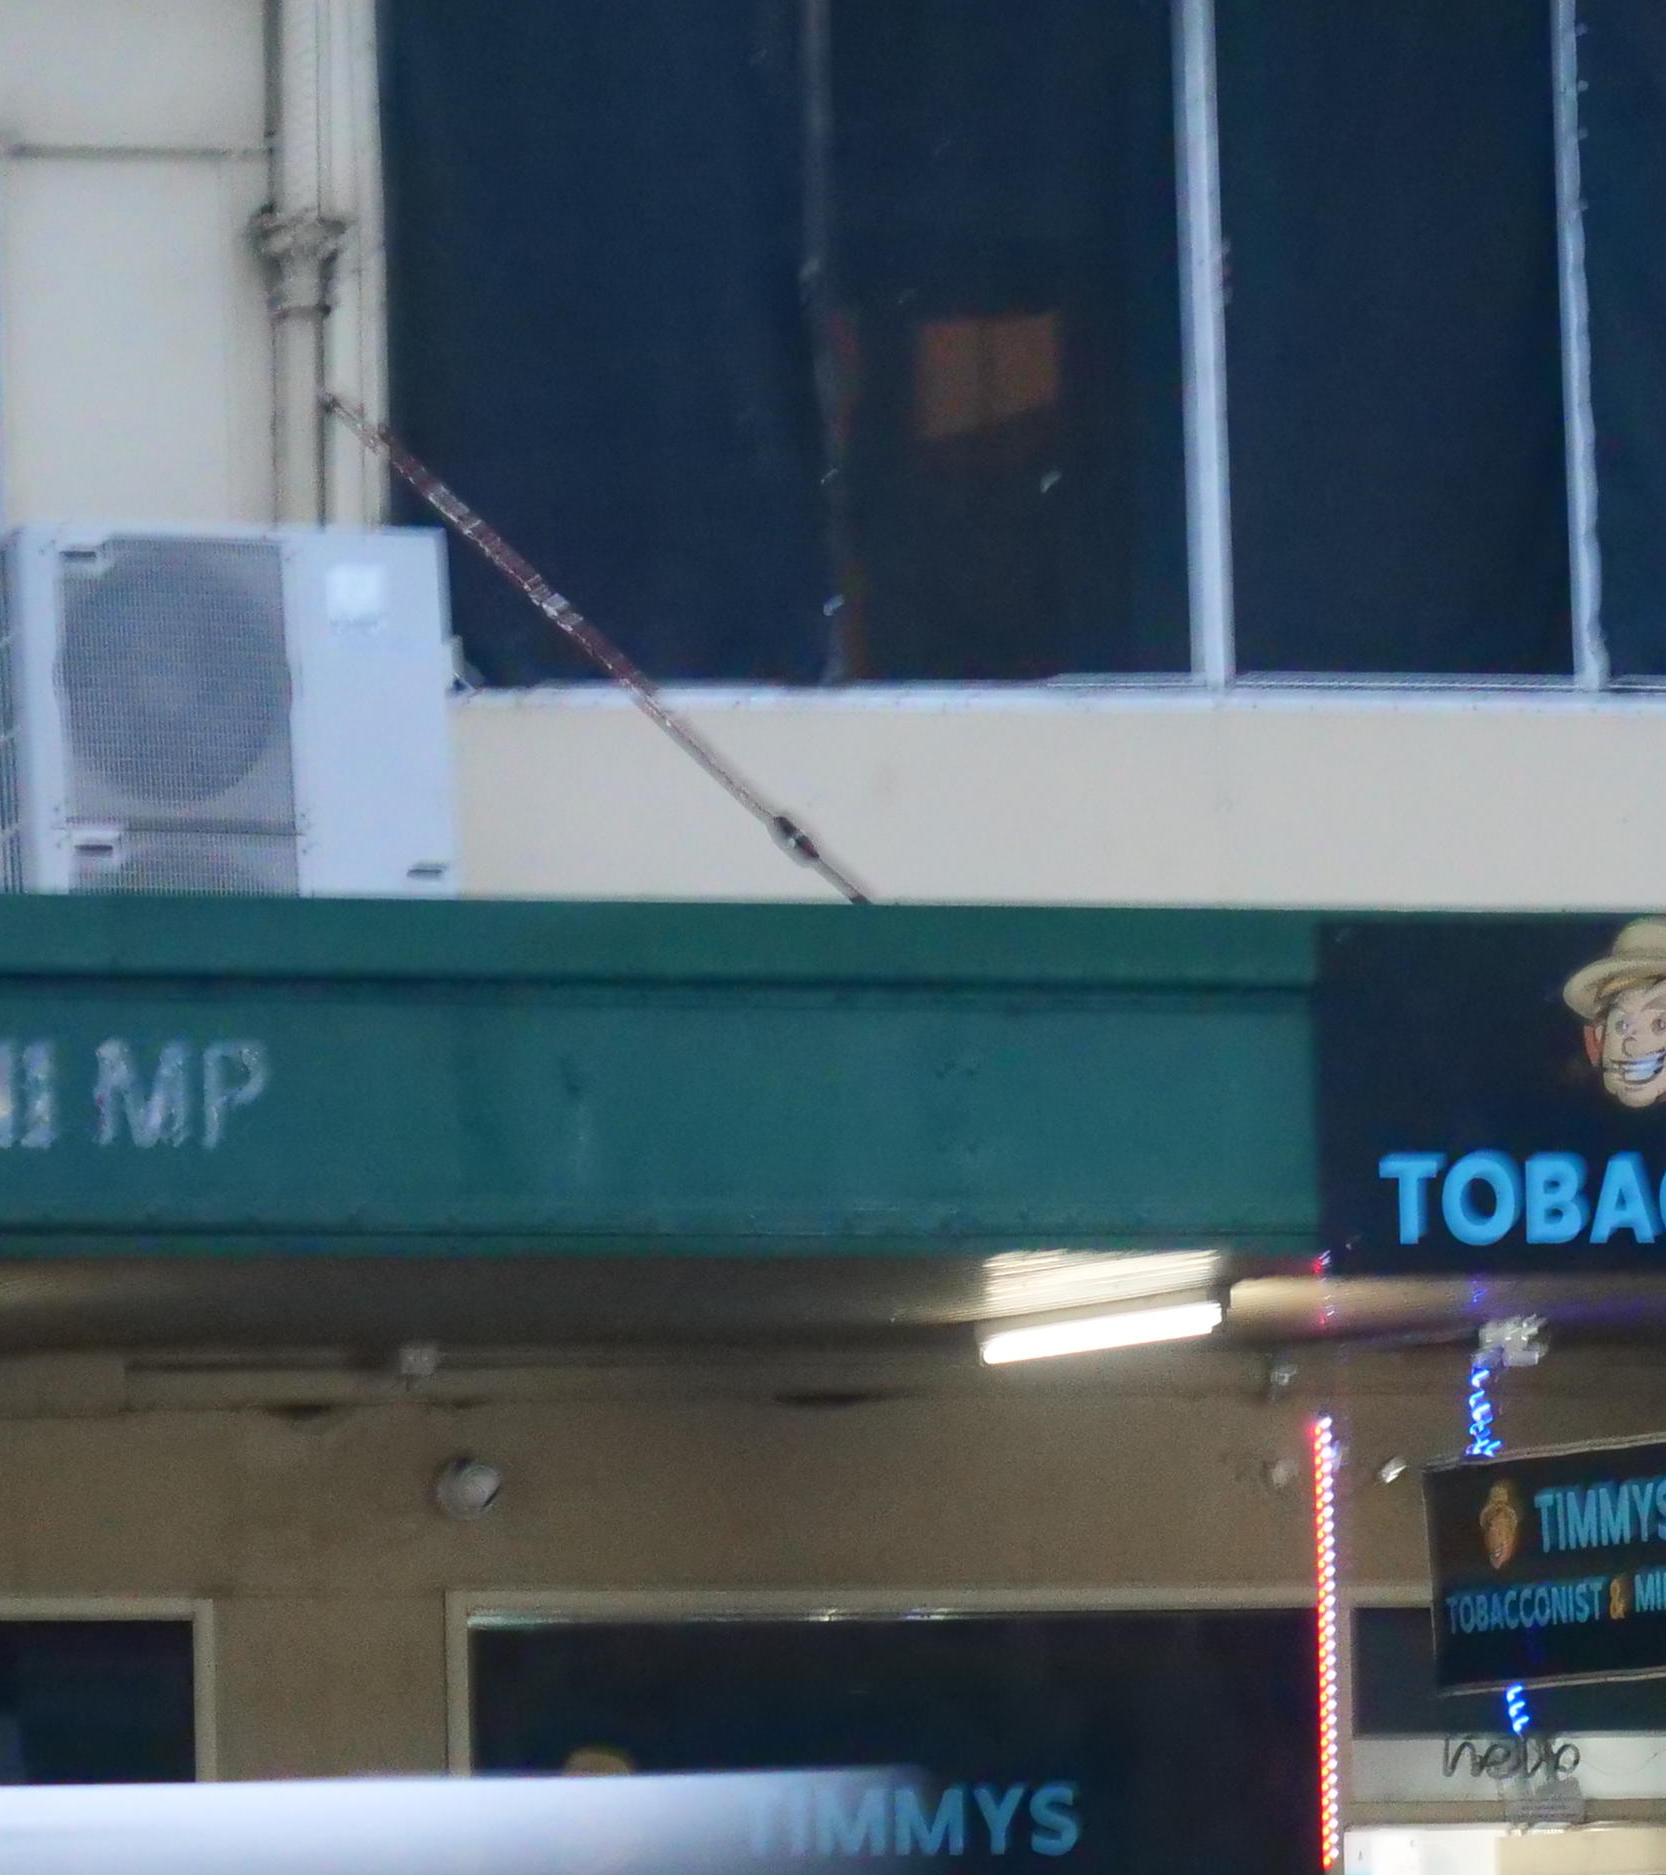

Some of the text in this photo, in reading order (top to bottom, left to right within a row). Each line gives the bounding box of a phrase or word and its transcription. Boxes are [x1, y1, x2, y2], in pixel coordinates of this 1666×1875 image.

[96, 1036, 270, 1149] MP
[1446, 1574, 1609, 1635] TOBACCONIST
[1609, 1573, 1628, 1620] &
[741, 1782, 1080, 1857] TIMMYS
